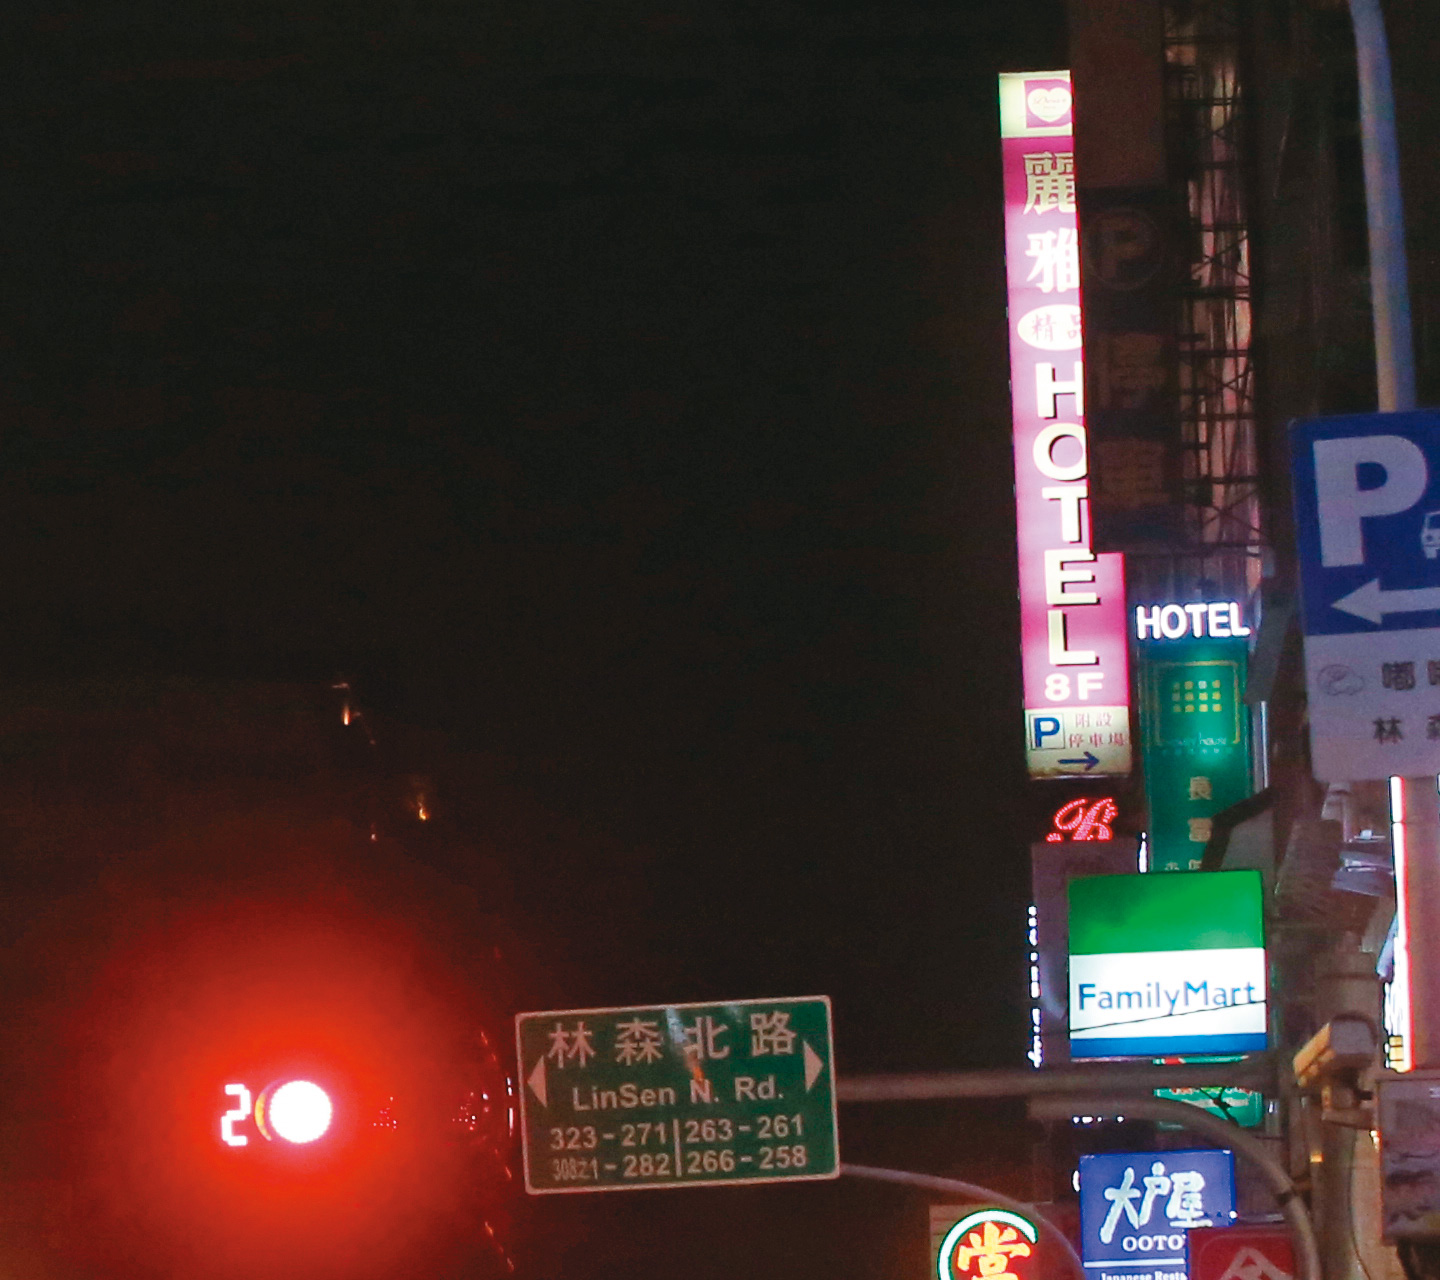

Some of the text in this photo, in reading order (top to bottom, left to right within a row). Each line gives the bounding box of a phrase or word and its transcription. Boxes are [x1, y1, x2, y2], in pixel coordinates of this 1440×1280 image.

[1033, 361, 1100, 668] HOTEL
[1312, 434, 1427, 568] P
[1135, 602, 1251, 640] HOTEL
[1044, 672, 1104, 701] 8F
[1033, 717, 1060, 747] P
[1078, 979, 1257, 1014] FamilyMart
[547, 1010, 797, 1070] 林森北路
[572, 1075, 785, 1112] LinSen N. Rd.
[1122, 1235, 1186, 1252] OOTO
